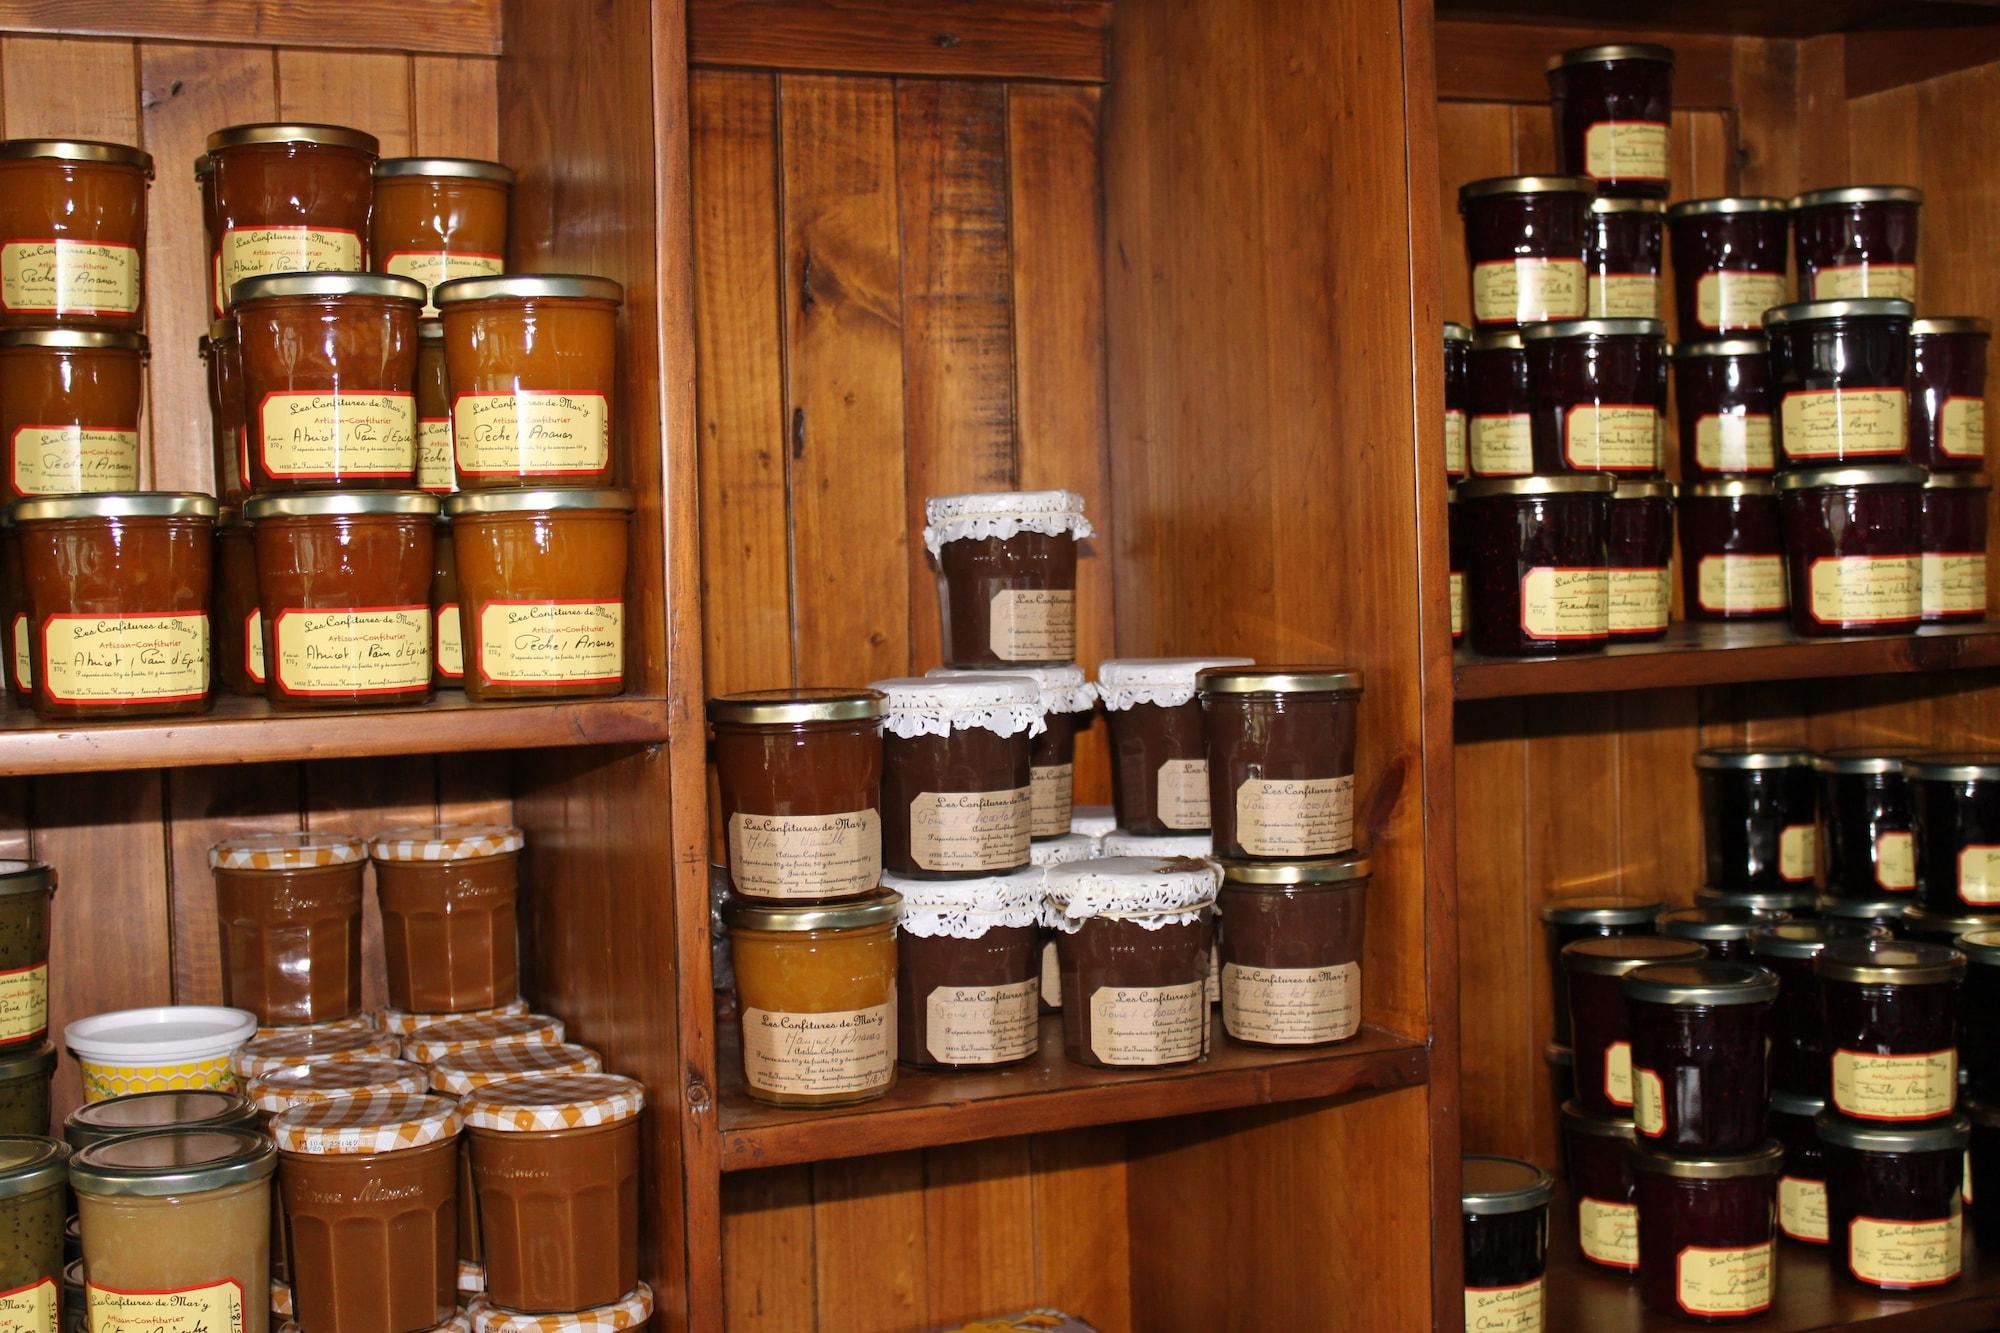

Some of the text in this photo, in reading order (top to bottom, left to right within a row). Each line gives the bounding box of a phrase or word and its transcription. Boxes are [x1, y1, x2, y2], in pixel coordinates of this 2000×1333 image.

[236, 238, 250, 248] Les
[252, 232, 298, 244] Confitures
[19, 249, 36, 260] Les
[290, 403, 311, 415] Les
[312, 397, 366, 413] Confitures
[381, 397, 406, 419] Mar'y
[473, 397, 591, 417] Les de Mar'y
[354, 423, 377, 441] Pain
[528, 424, 573, 440] Ananas
[304, 620, 326, 633] Les
[326, 615, 382, 628] Confitures
[396, 613, 421, 632] Mar'y
[508, 612, 530, 624] Les
[530, 607, 581, 620] Confitures
[595, 605, 619, 625] Mar'y
[73, 626, 97, 639] Les
[97, 621, 157, 634] Confitures
[171, 618, 199, 640] Mar'y
[99, 640, 182, 649] Artisan-Confiturier
[575, 634, 615, 649] Ananas
[140, 649, 166, 665] Pain
[368, 643, 390, 659] Pain
[1261, 784, 1284, 795] Les
[1285, 784, 1333, 798] Confitures
[936, 797, 959, 808] Les
[960, 796, 1009, 811] Confitures
[743, 818, 764, 831] Les
[763, 819, 820, 836] Confitures
[835, 817, 867, 830] Mar'y
[1234, 968, 1252, 980] Les
[1253, 971, 1305, 986] Confitures
[1306, 975, 1317, 984] de
[953, 990, 1023, 1004] Les Confitures
[1115, 992, 1139, 1003] Les
[1140, 991, 1190, 1006] Confitures
[761, 1014, 779, 1028] Les
[780, 1016, 839, 1032] Confitures
[853, 1012, 885, 1026] Mar'y
[105, 1294, 151, 1311] Confitures
[171, 1295, 210, 1311] Mar'y
